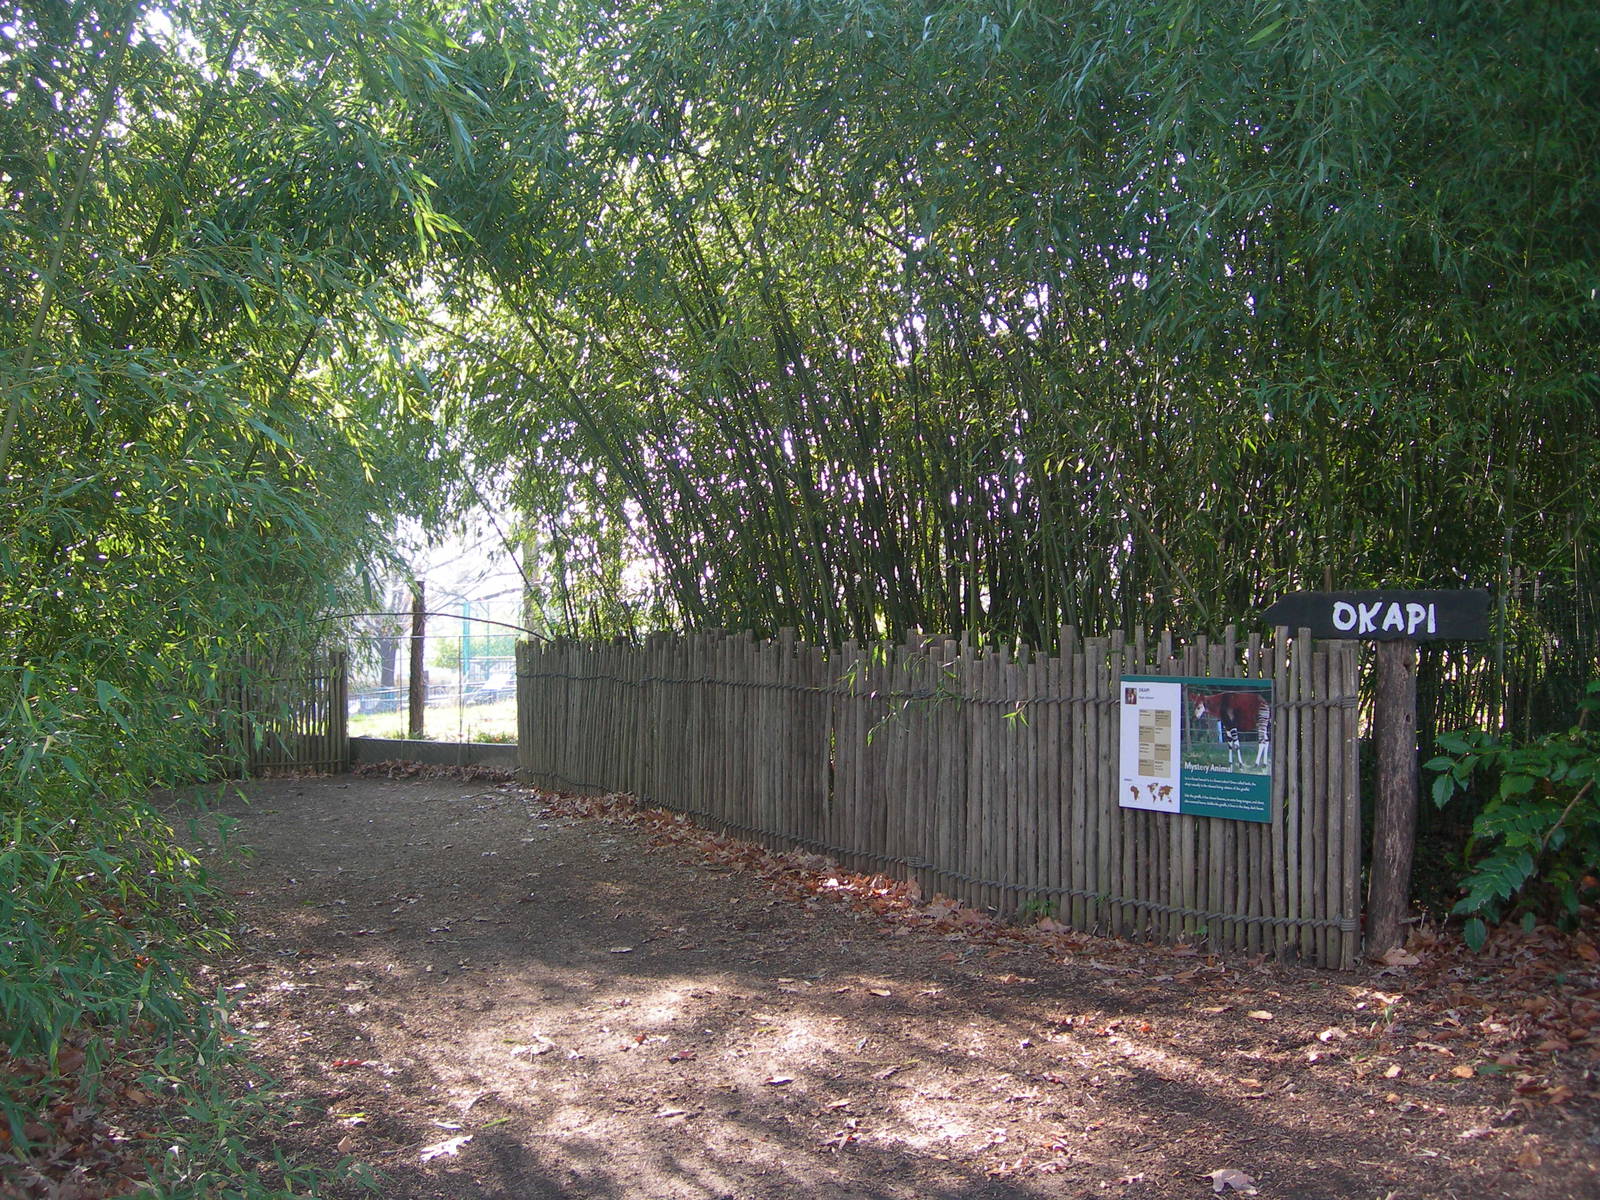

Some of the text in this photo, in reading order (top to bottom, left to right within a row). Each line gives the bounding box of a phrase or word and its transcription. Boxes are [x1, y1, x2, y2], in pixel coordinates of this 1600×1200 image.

[1332, 600, 1436, 635] OKAPI
[1184, 761, 1233, 774] Mystery Animal
